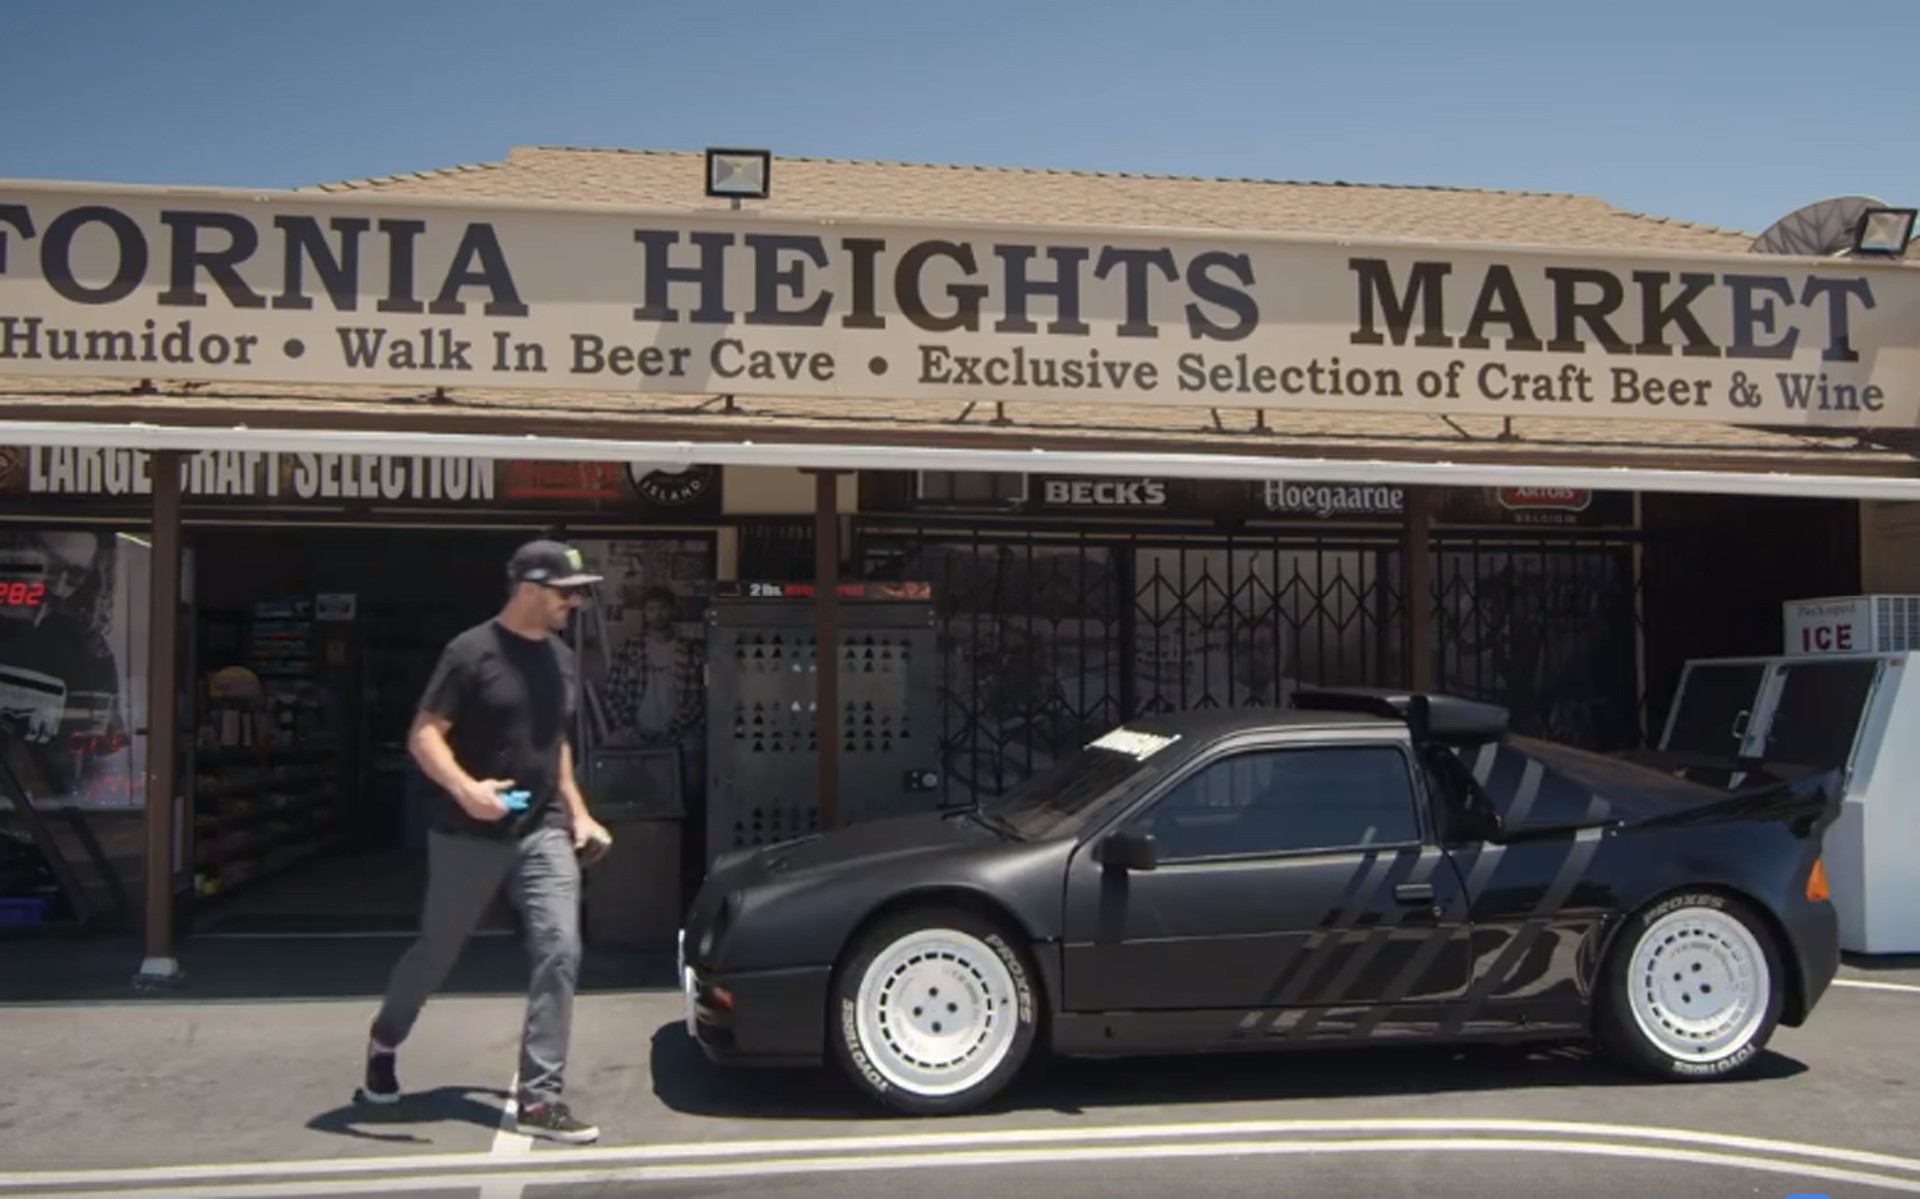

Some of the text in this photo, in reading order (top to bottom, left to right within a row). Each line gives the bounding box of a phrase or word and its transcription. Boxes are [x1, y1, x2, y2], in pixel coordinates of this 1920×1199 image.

[633, 229, 1260, 342] HEIGHTS
[1348, 257, 1876, 363] MARKET
[0, 316, 1884, 412] Humidor Walk In Beer Cave Exclusive Selection of Craft Beer & Wine
[28, 446, 152, 495] LARGE
[181, 450, 279, 496] RAFT
[294, 452, 494, 500] SELECTION
[642, 479, 700, 501] ISLAND
[1044, 478, 1166, 505] BECK'S
[1803, 624, 1852, 653] ICE
[1643, 894, 1725, 926] PROXES
[985, 934, 1031, 1024] PROXES
